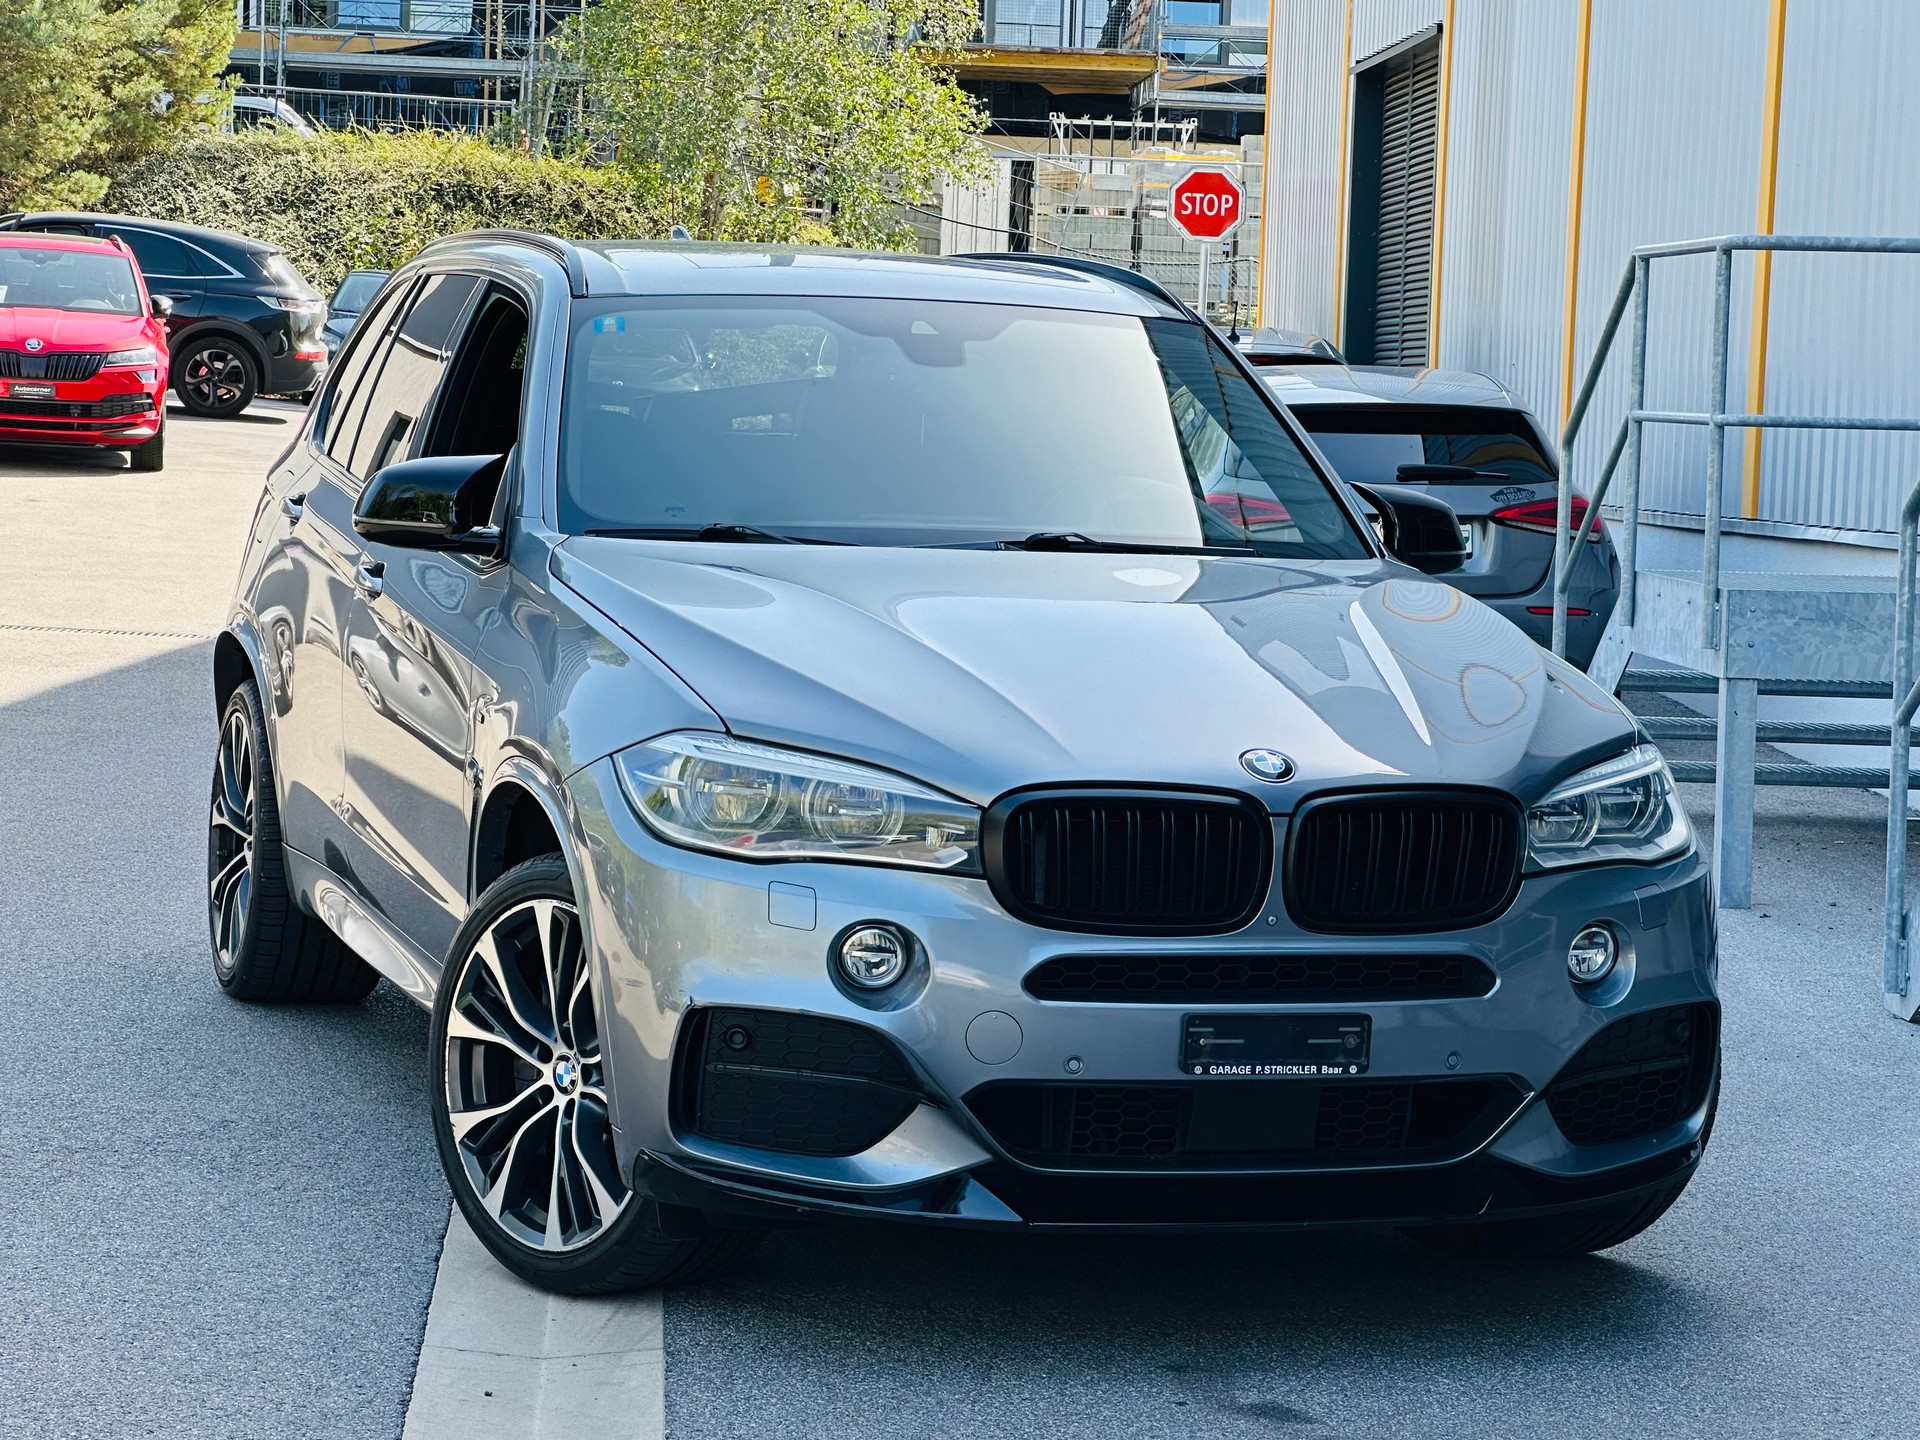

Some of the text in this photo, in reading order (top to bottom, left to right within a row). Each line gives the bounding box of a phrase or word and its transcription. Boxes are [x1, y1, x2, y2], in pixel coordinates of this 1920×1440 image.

[1181, 192, 1233, 216] STOP
[1209, 1065, 1343, 1074] GARAGE P.STRICKLER Baar
